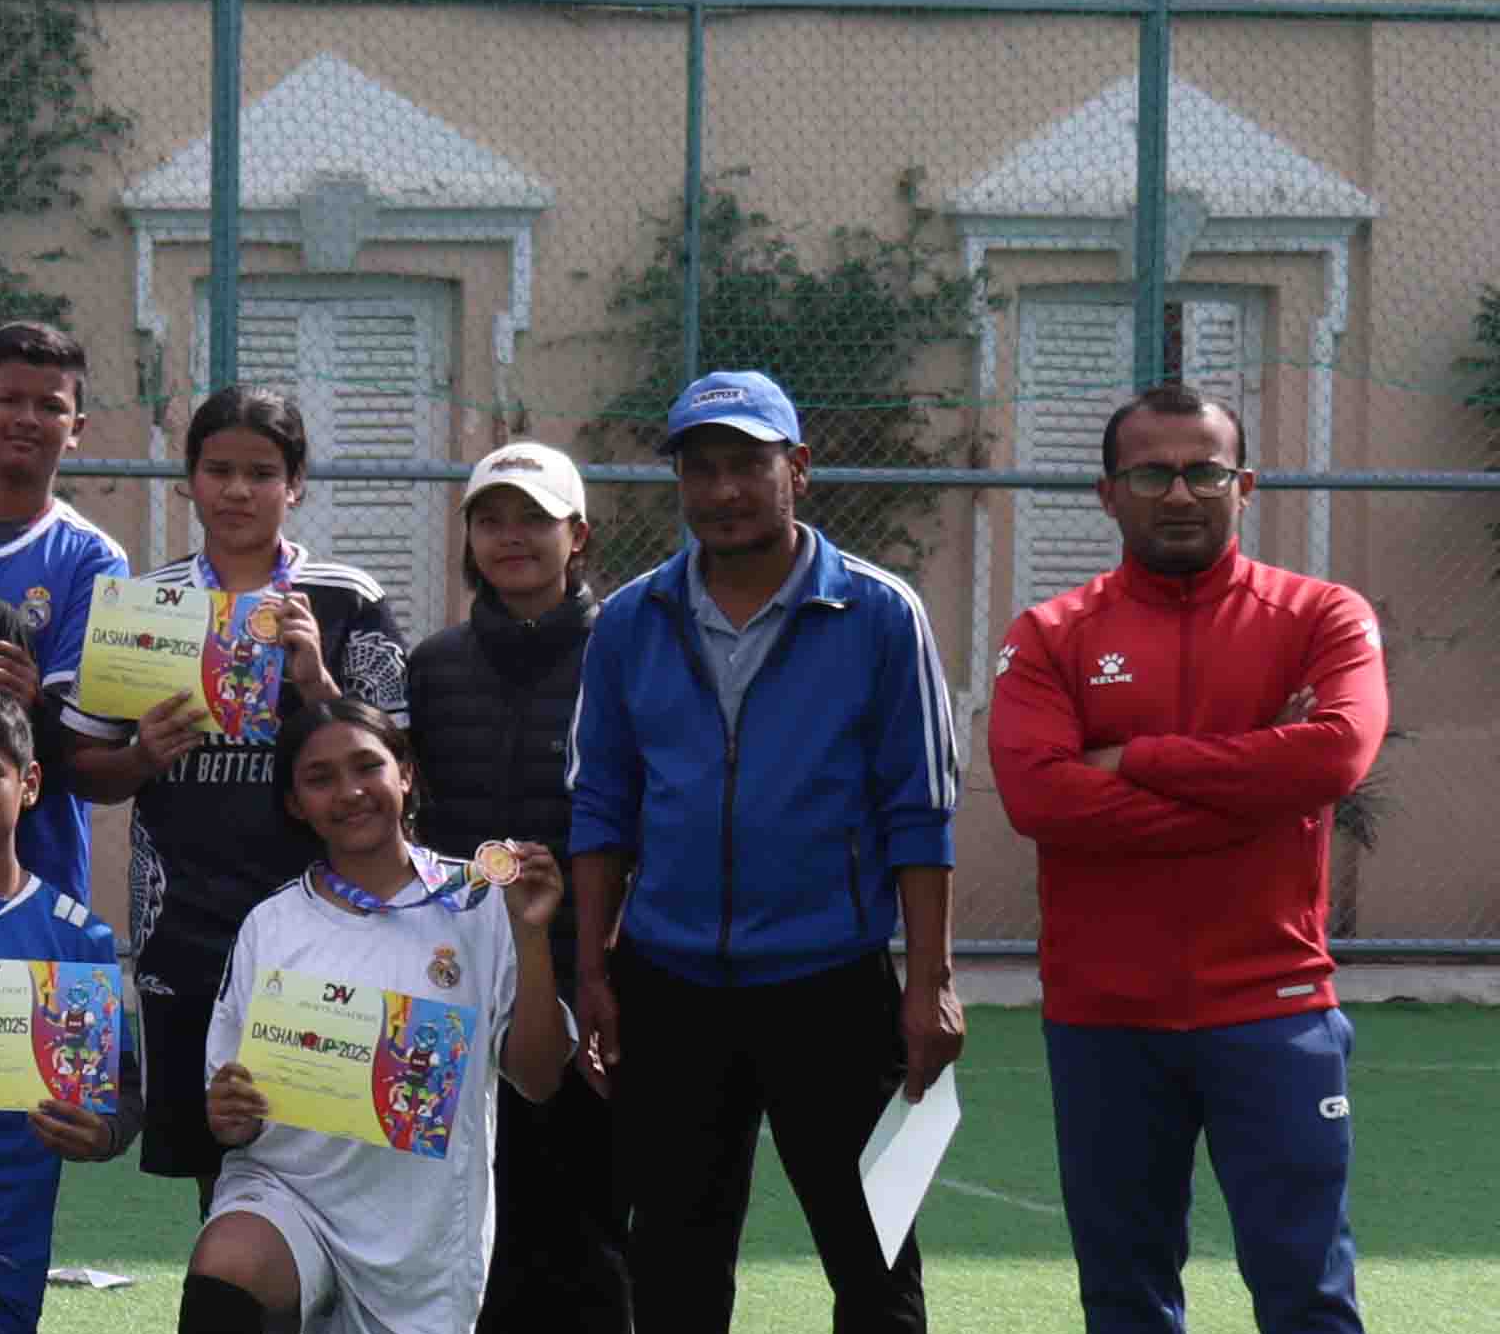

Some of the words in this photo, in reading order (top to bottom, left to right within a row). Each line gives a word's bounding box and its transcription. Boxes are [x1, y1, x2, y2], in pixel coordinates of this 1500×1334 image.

[155, 588, 185, 606] DAV
[92, 628, 140, 646] DASHAIN
[140, 632, 199, 657] UP-2025
[164, 754, 188, 782] LY
[197, 753, 275, 783] BETTER
[323, 982, 356, 1004] DAV
[252, 1022, 304, 1047] DASHAIN
[304, 1031, 372, 1063] UP-2025
